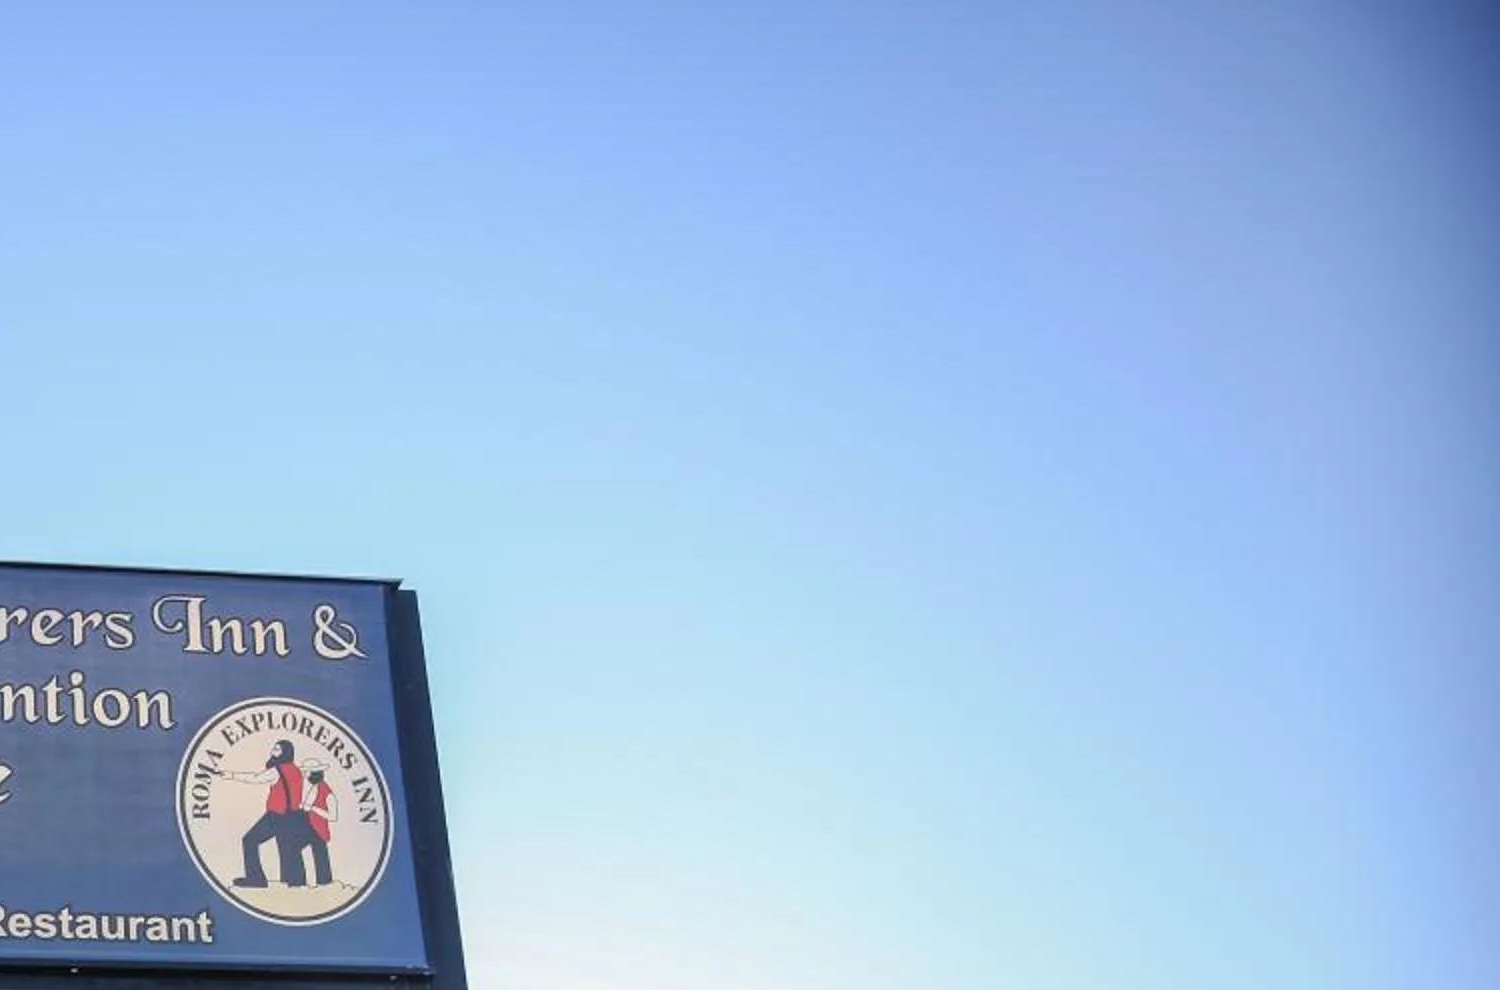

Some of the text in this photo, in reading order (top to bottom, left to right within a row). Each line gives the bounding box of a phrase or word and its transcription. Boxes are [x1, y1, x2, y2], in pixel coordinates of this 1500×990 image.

[152, 596, 290, 657] Inn
[312, 604, 367, 661] &
[191, 711, 378, 824] ROMA EXPLORERS INN
